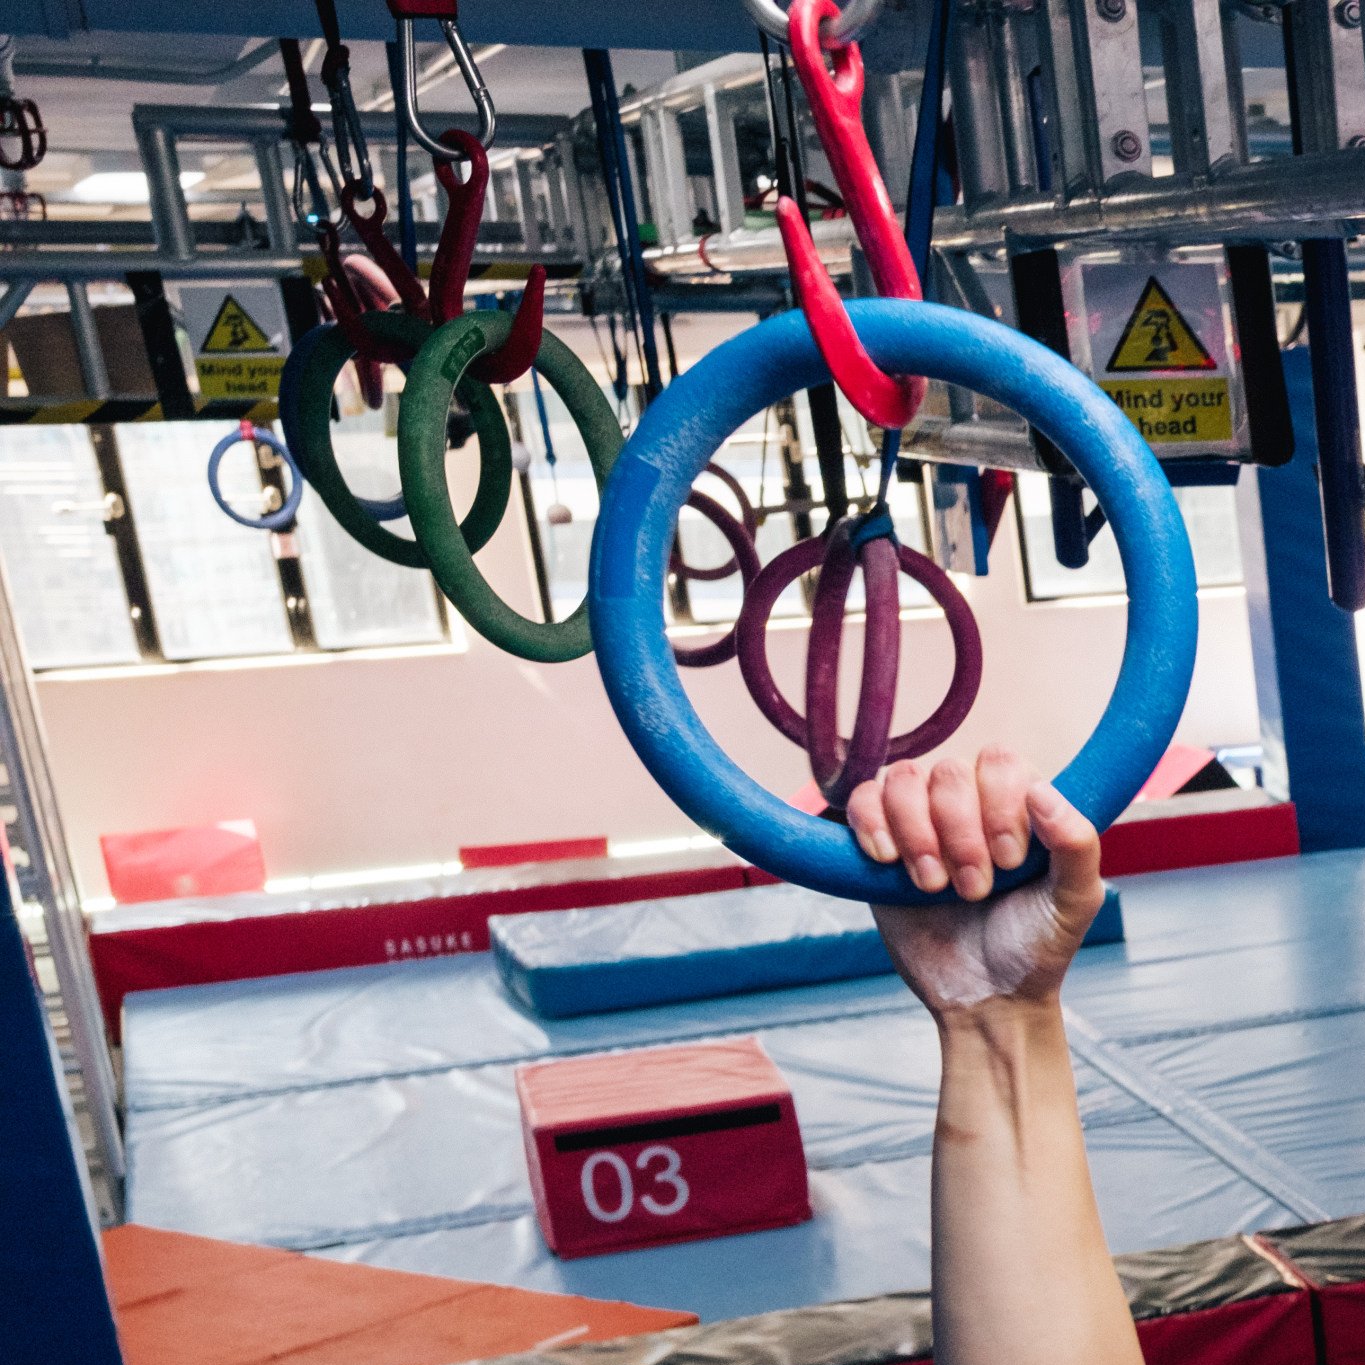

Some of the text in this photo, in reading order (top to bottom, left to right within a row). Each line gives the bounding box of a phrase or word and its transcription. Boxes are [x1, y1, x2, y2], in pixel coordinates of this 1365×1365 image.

[247, 366, 281, 379] you
[1106, 389, 1224, 412] Mind your
[1138, 415, 1197, 435] head
[581, 1145, 690, 1223] 03
